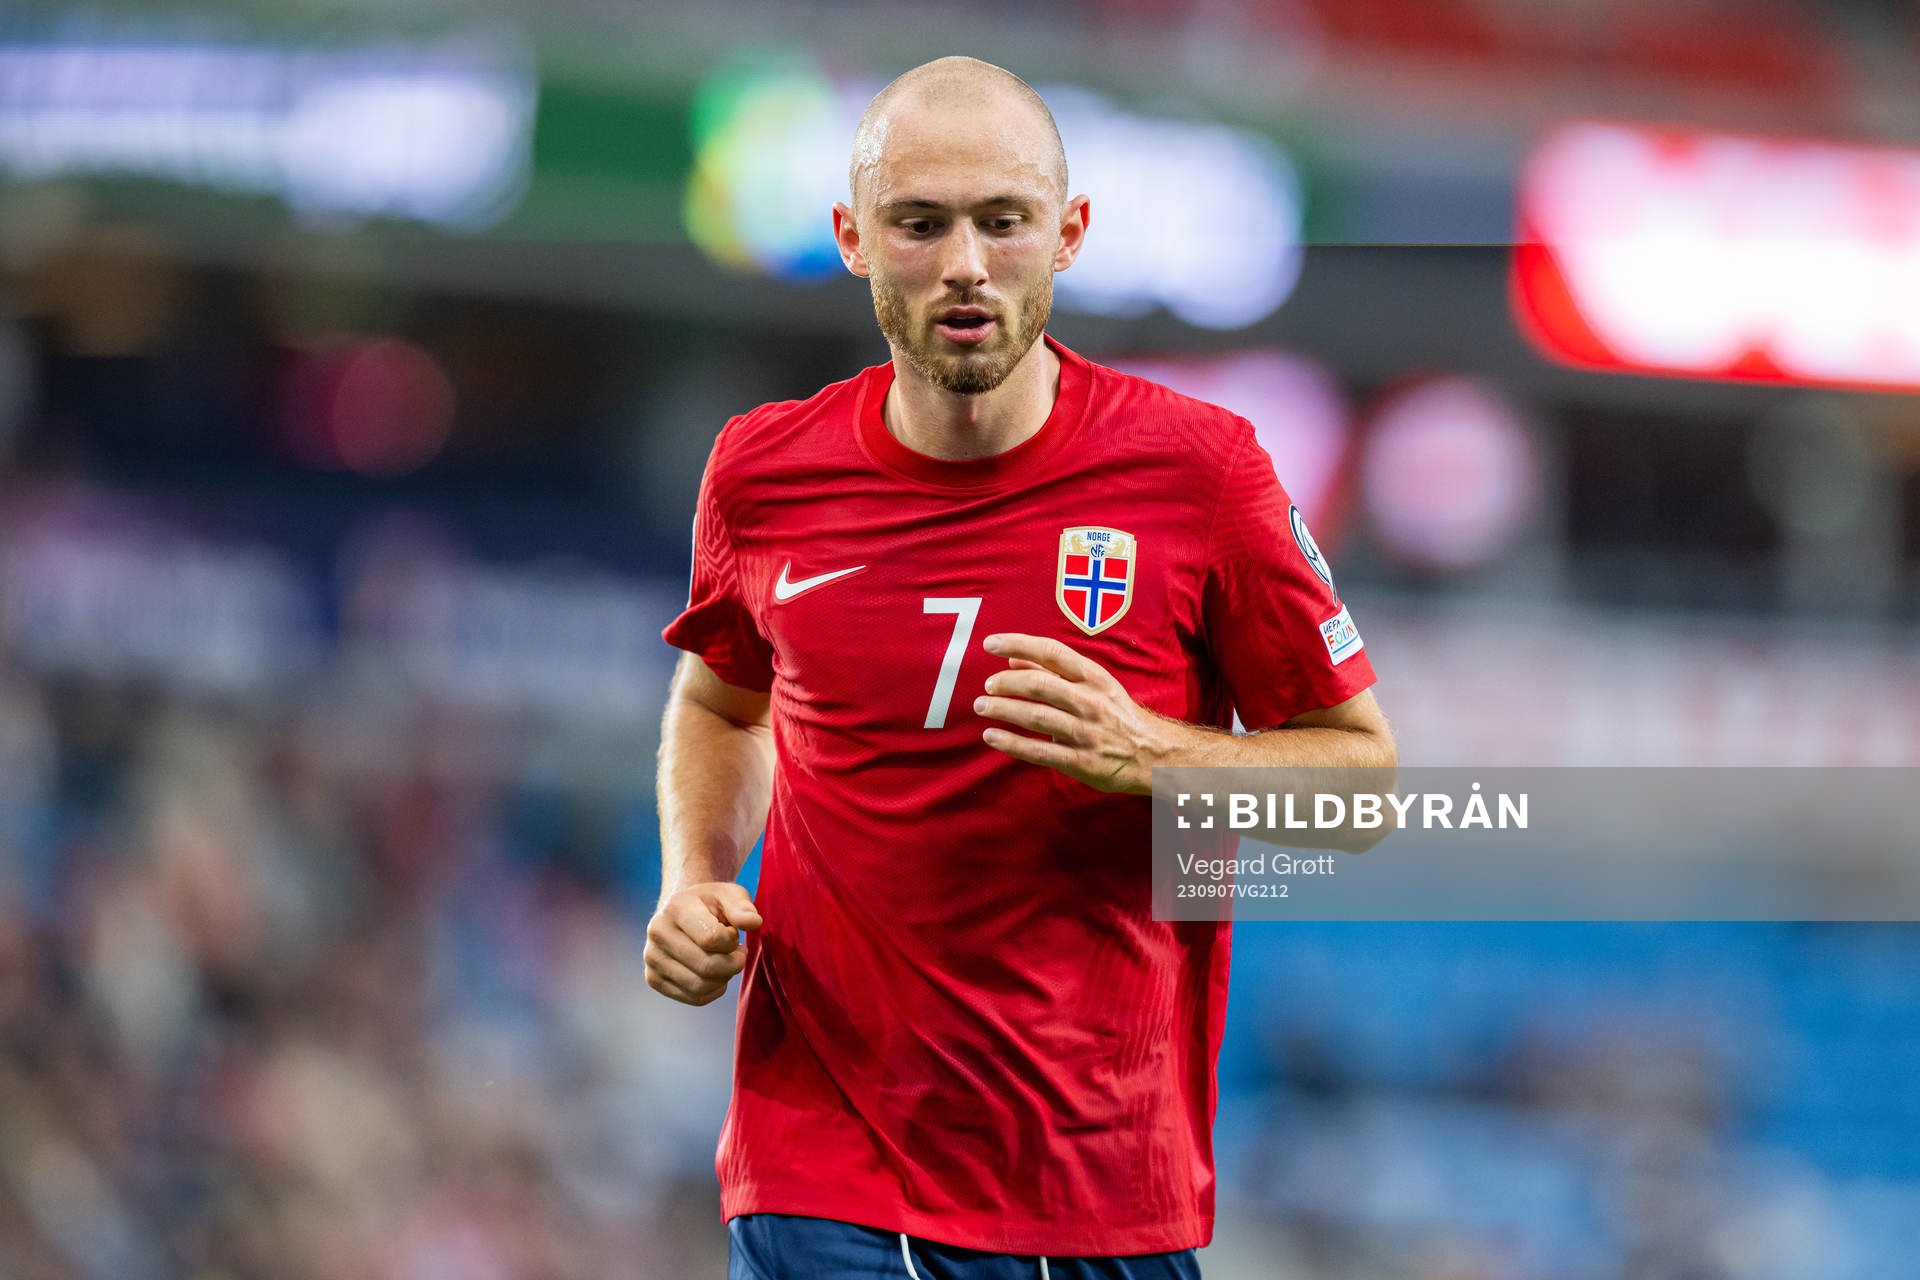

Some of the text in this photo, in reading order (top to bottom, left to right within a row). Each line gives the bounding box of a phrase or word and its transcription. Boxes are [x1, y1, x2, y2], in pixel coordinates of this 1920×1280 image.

[1086, 531, 1111, 542] NORGE
[1323, 618, 1341, 635] UEFA
[923, 597, 983, 729] 7
